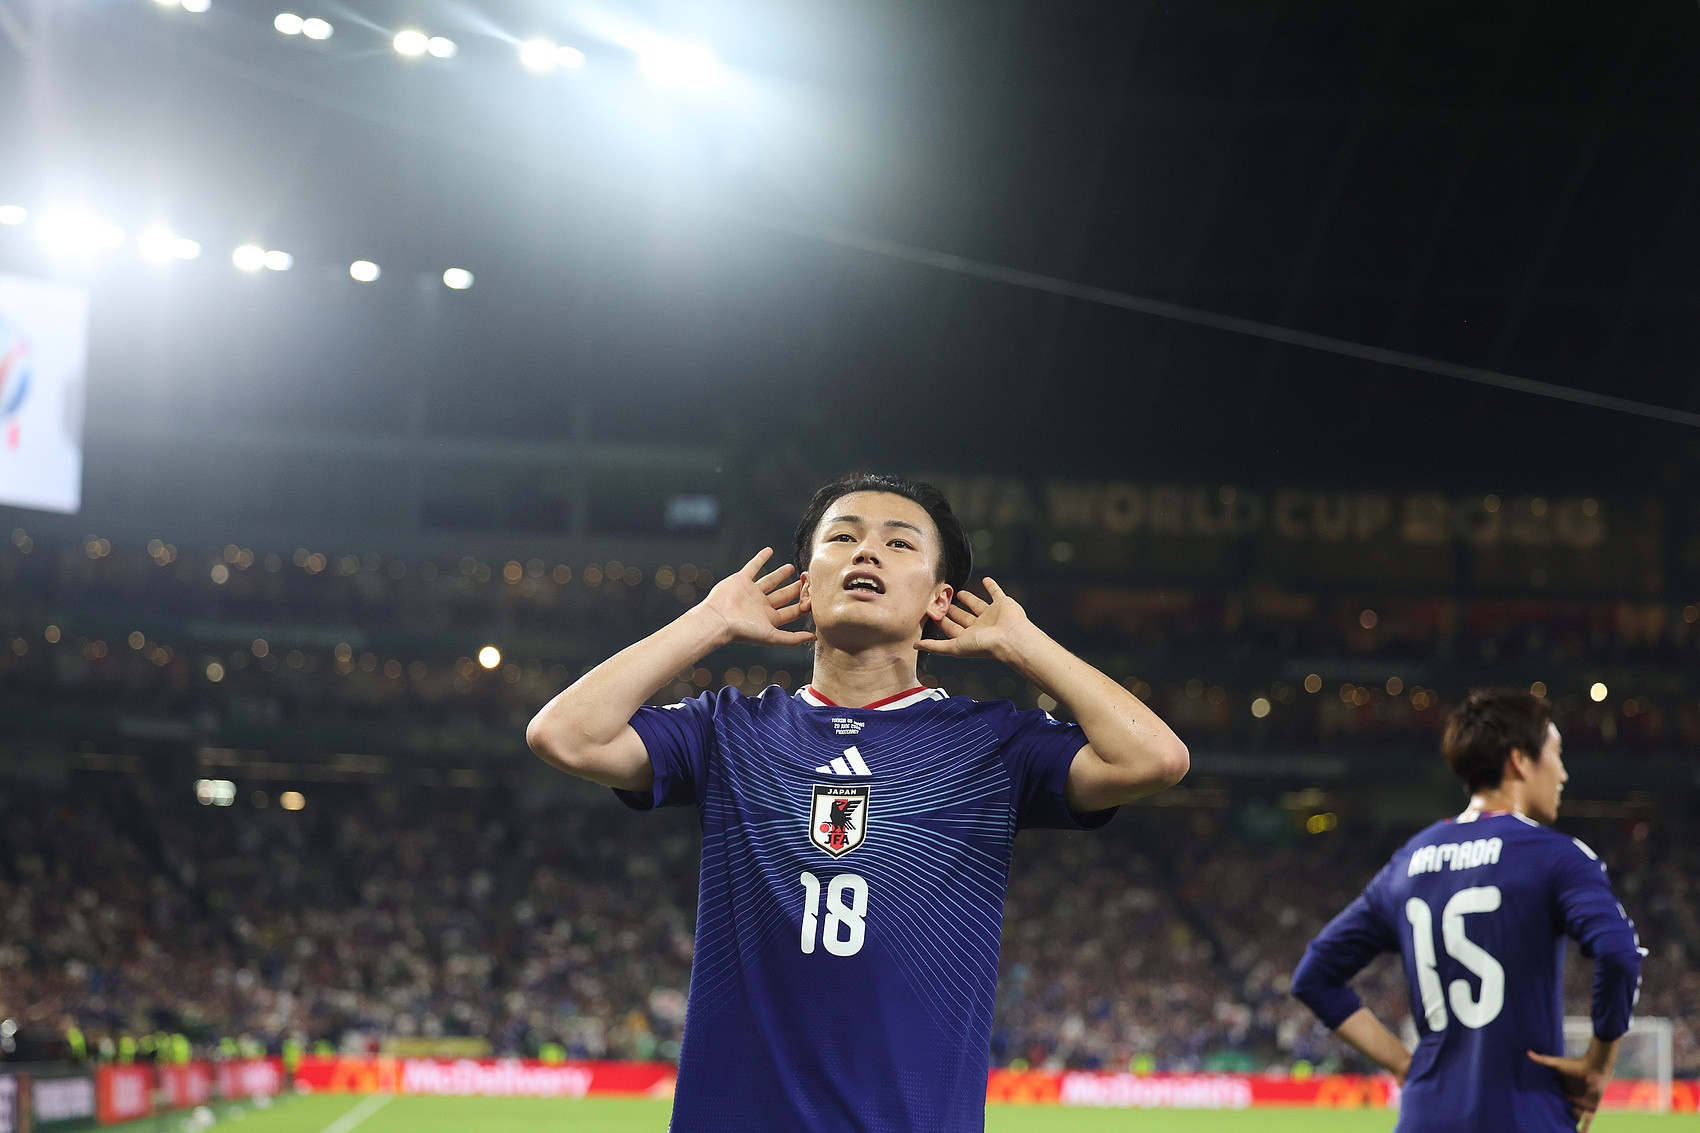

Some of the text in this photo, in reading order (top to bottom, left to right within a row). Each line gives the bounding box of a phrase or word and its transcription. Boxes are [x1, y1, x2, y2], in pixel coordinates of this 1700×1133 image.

[1048, 480, 1262, 536] WORLD
[1275, 488, 1394, 542] CUP
[824, 834, 850, 845] JFA
[800, 871, 869, 957] 18
[1405, 885, 1505, 1032] 15
